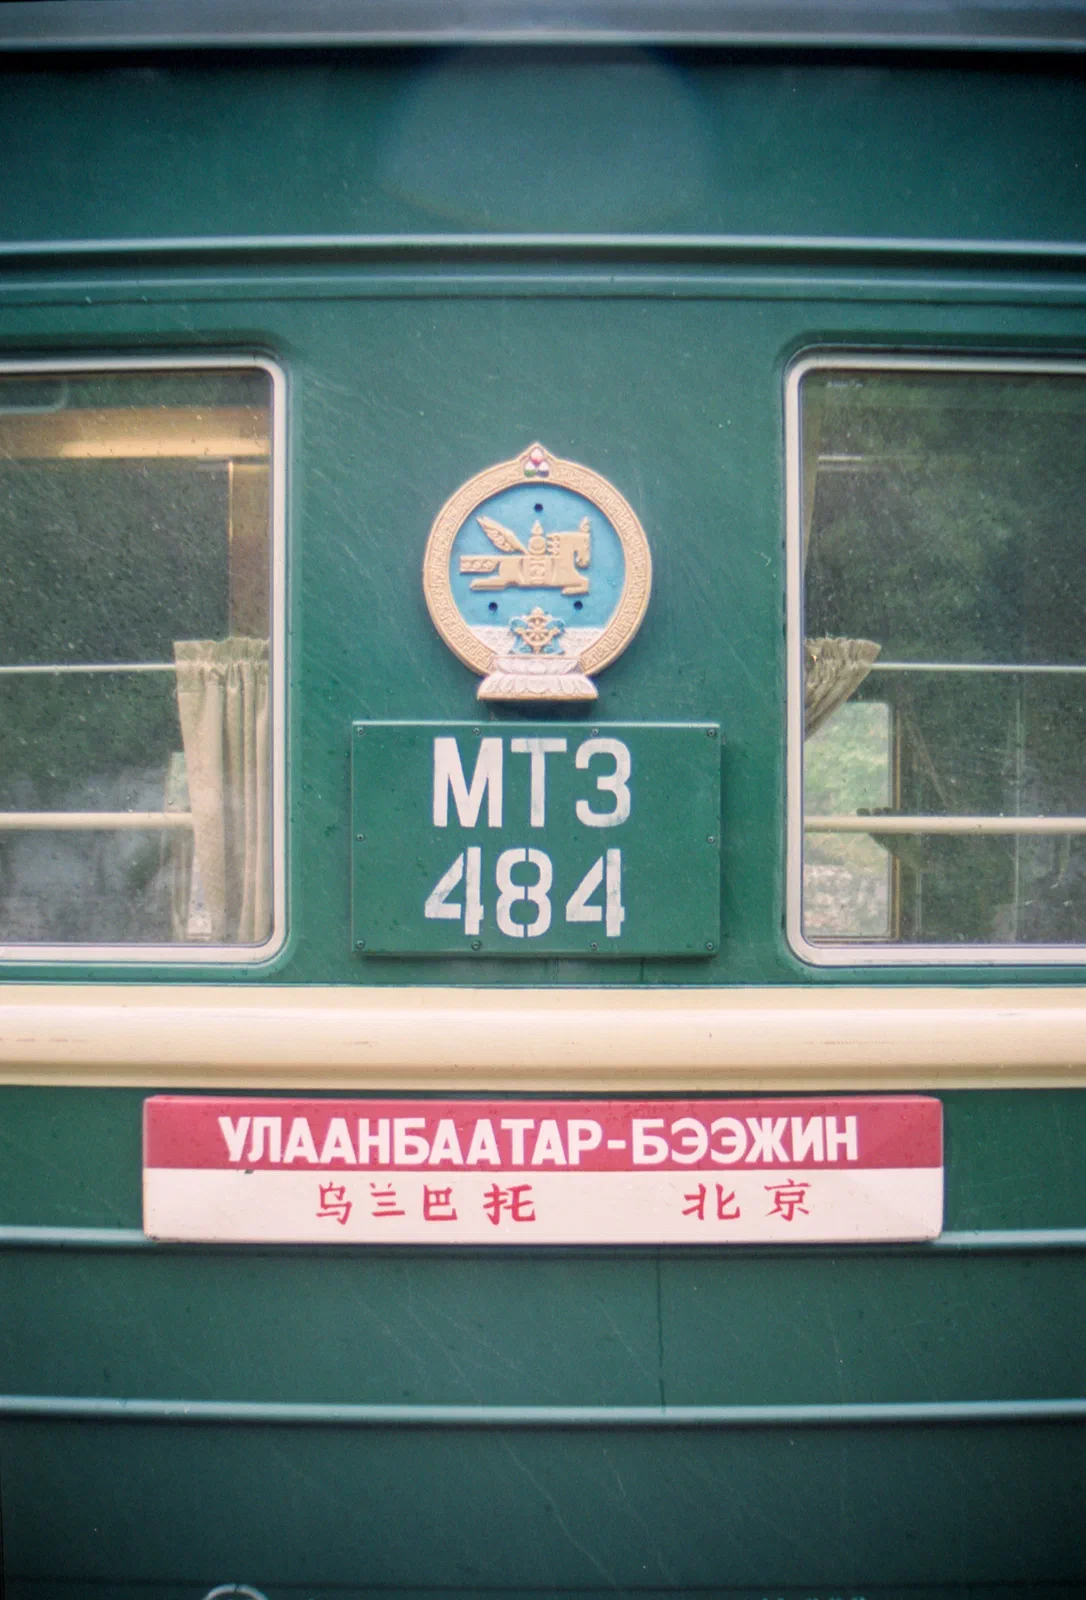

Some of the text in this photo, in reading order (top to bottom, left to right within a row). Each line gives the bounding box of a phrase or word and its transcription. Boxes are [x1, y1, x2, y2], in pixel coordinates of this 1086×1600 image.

[424, 846, 626, 939] 484
[217, 1115, 860, 1166] УЛААНБААТАР-БЭЭЖИН
[315, 1178, 812, 1226] 乌兰巴托 北京
